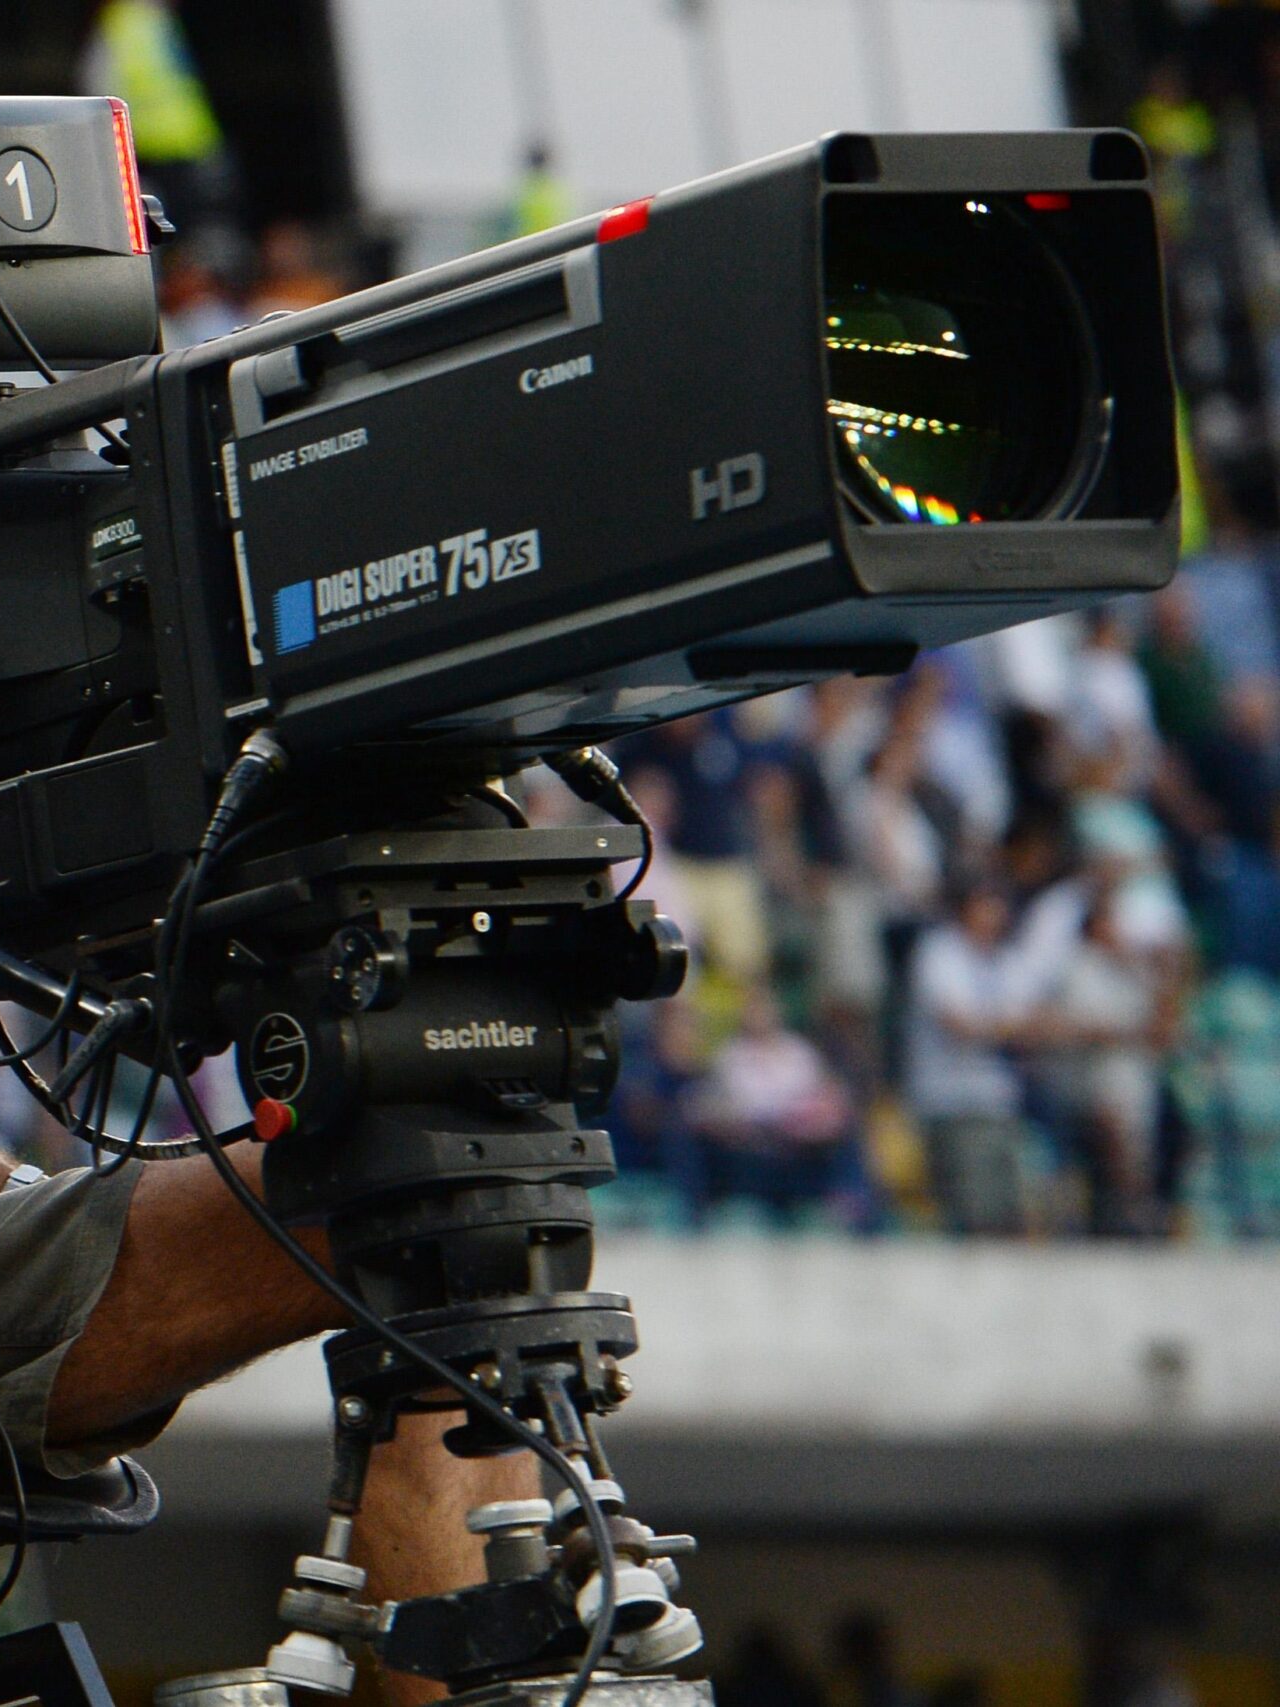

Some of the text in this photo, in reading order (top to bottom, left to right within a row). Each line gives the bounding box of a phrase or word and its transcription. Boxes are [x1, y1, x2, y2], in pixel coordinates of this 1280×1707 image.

[5, 161, 33, 220] 1
[520, 354, 593, 394] Canon
[249, 450, 296, 481] IMAGE
[297, 427, 369, 466] STABILIZER
[691, 452, 764, 520] HD
[316, 566, 363, 617] DIGI
[364, 545, 438, 601] SUPER
[440, 528, 488, 596] 75
[423, 1020, 538, 1051] sachtler
